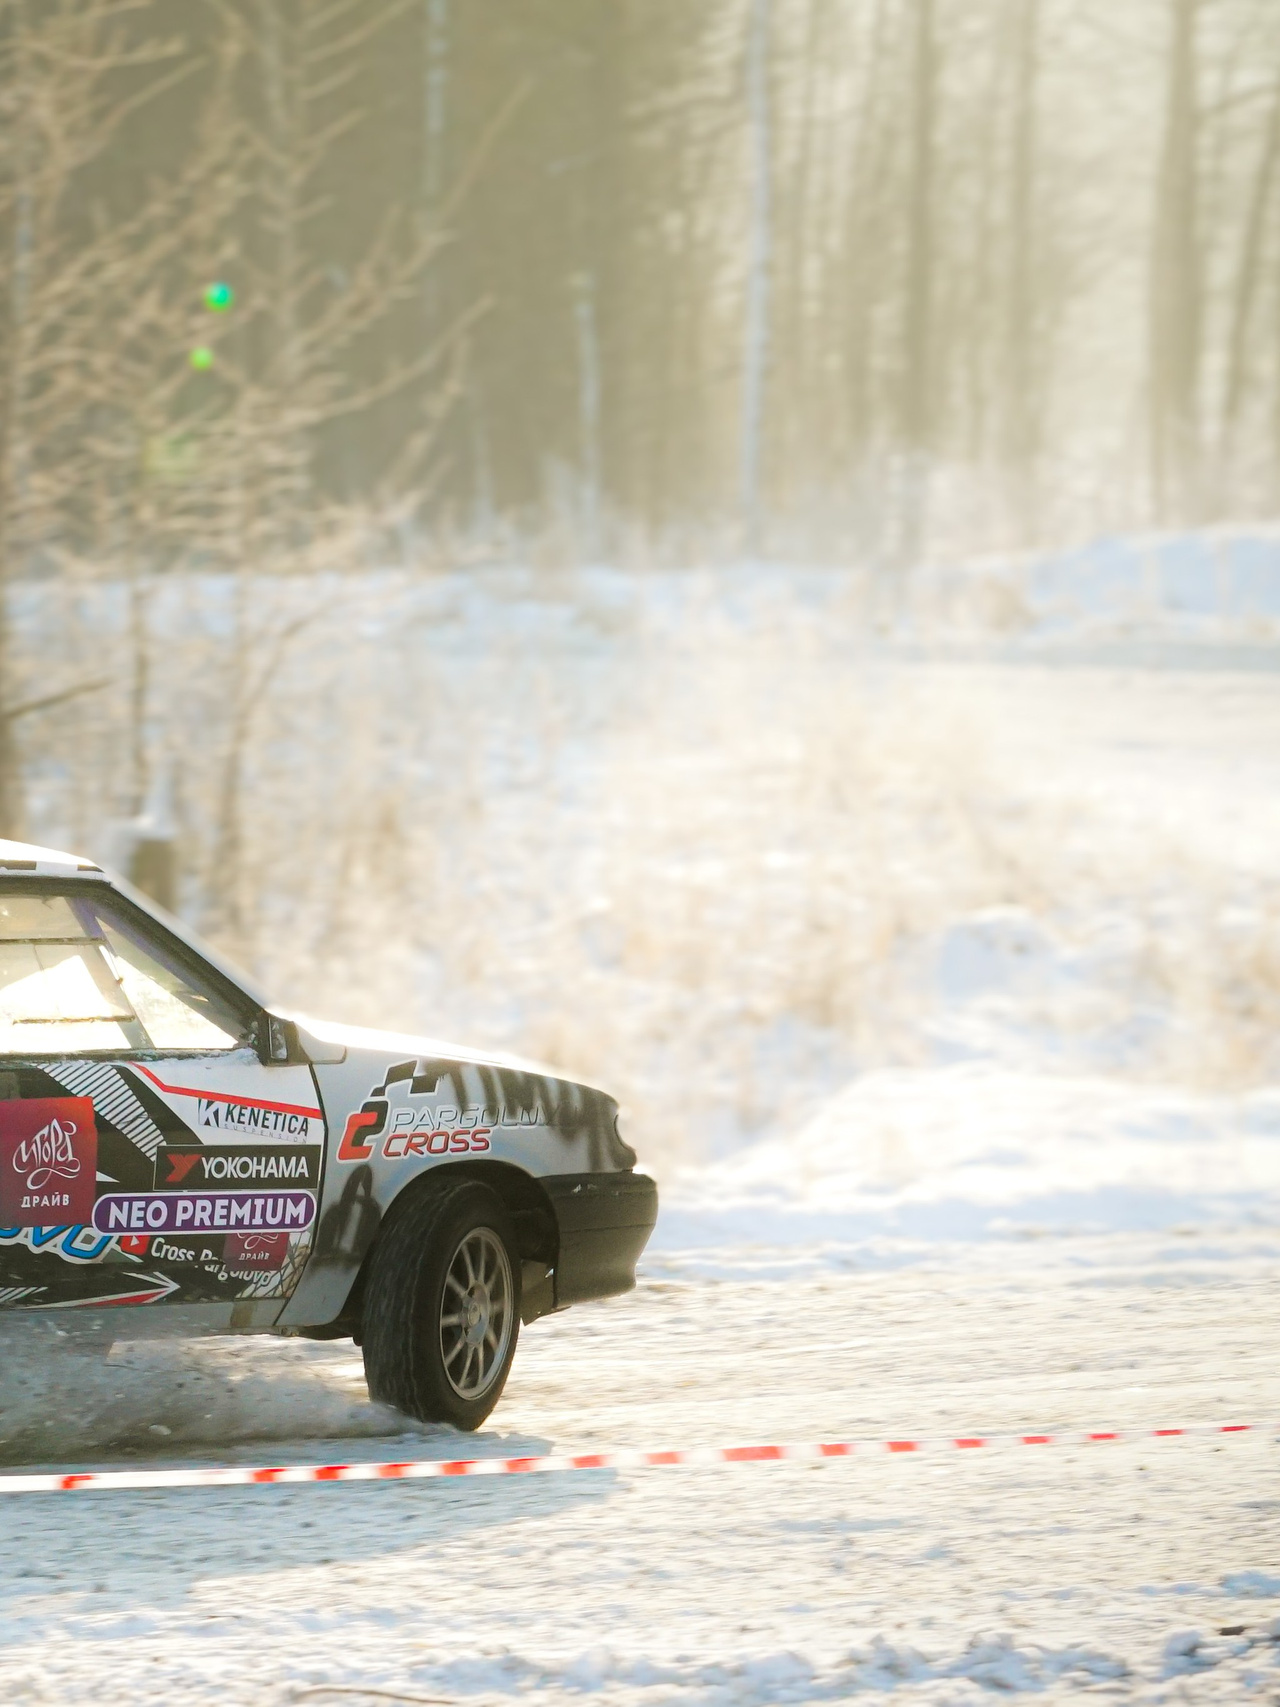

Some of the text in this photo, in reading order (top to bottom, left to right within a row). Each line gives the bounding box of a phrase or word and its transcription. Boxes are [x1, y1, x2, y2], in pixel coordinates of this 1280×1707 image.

[224, 1103, 309, 1137] KENETICA
[383, 1128, 492, 1158] CROSS
[201, 1156, 310, 1179] YOKOHAMA
[21, 1191, 70, 1208] ДРАЙВ
[108, 1197, 308, 1229] NEO PREMIUM
[151, 1237, 195, 1262] Cross
